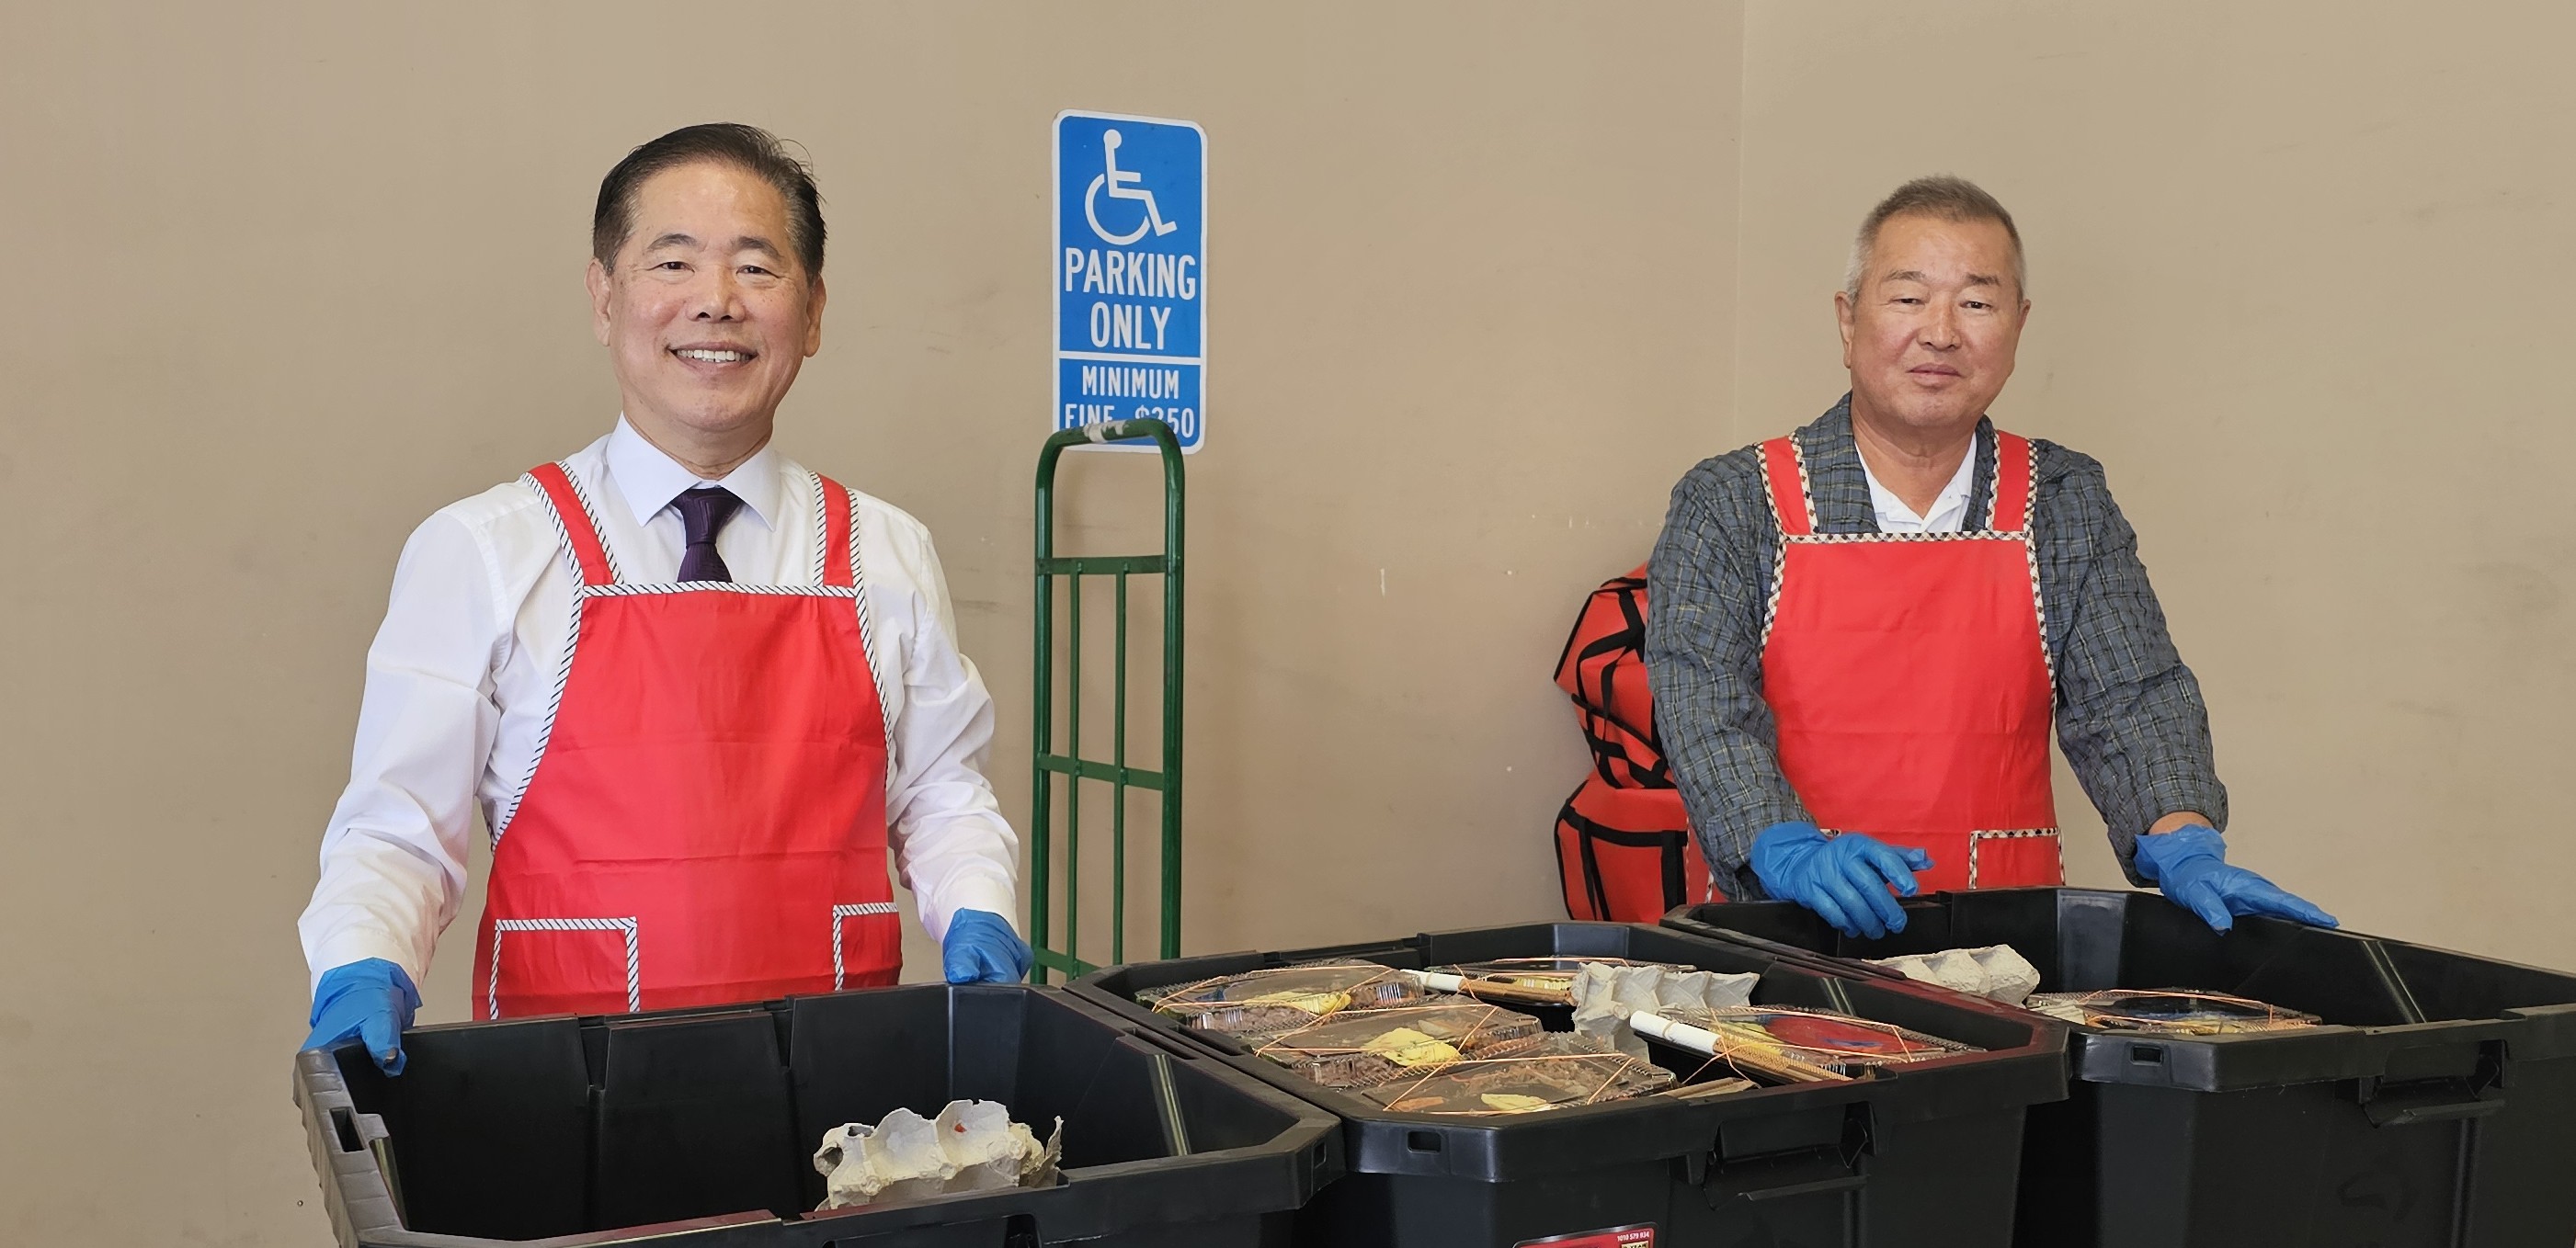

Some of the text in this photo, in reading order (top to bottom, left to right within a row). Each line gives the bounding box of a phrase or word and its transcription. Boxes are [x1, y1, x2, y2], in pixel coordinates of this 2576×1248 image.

[1065, 247, 1196, 300] PARKING
[1090, 301, 1171, 350] ONLY
[1082, 365, 1179, 400] MINIMUM
